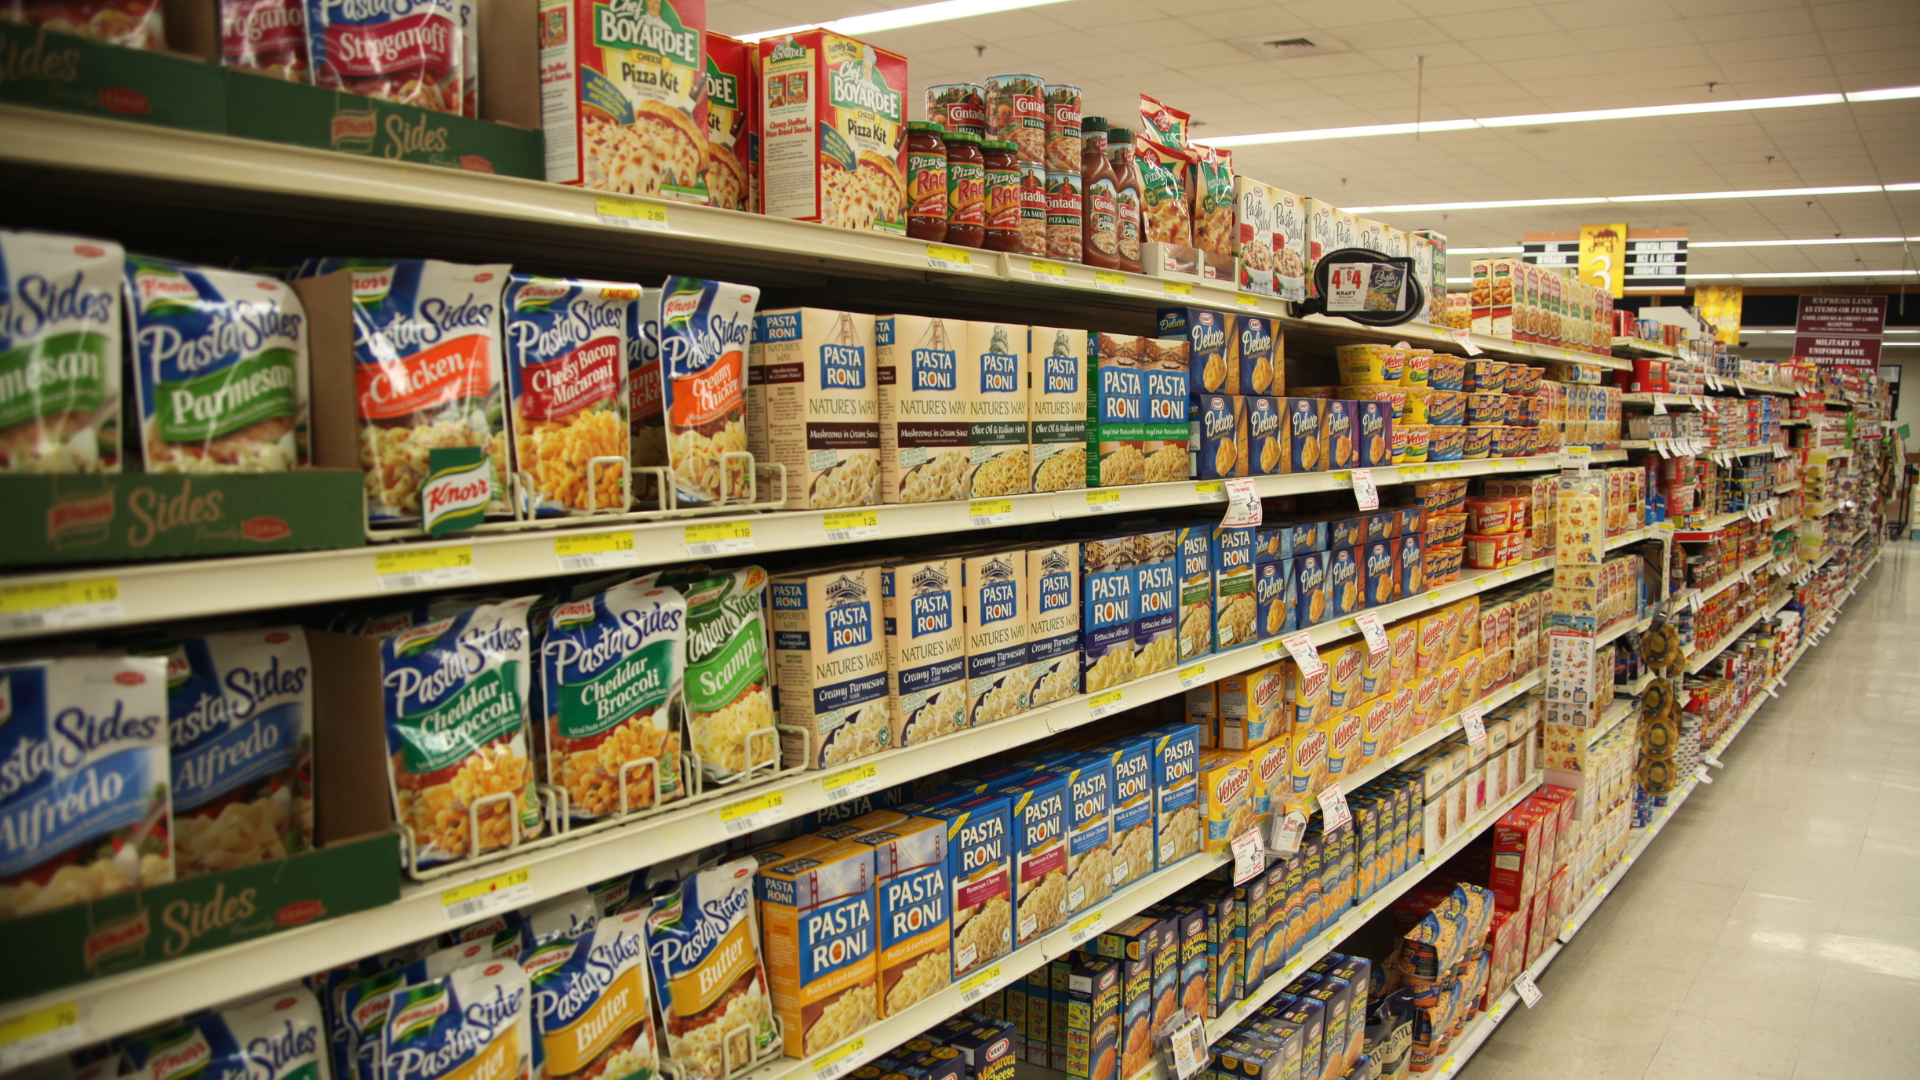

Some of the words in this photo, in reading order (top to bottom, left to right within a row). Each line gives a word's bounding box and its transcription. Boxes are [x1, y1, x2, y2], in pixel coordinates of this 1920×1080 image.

[340, 22, 447, 62] Stroganoff
[601, 9, 695, 63] BOYARDEE
[637, 51, 663, 65] CHEESE
[771, 47, 804, 62] BOYARDEE
[828, 44, 845, 54] Family
[847, 43, 857, 53] Size
[621, 61, 657, 86] Pizza
[660, 67, 679, 94] Kit
[840, 61, 861, 80] Chef
[834, 75, 898, 118] BOYARDEE
[770, 121, 786, 130] Cheesy
[787, 117, 807, 126] Stuffed
[857, 111, 875, 121] CHEESE
[766, 130, 777, 138] Pizza
[848, 118, 871, 138] Pizza
[873, 124, 887, 144] Kit
[910, 157, 934, 171] Pizza
[647, 210, 665, 222] 2.89
[1244, 192, 1264, 220] Pasta
[1048, 216, 1065, 224] PIZZA
[1332, 270, 1341, 289] 4
[1347, 270, 1362, 289] $4
[1374, 279, 1397, 288] Salad
[1591, 254, 1612, 292] 3
[518, 285, 566, 304] Knorr
[608, 288, 634, 299] NEW!
[420, 293, 493, 345] Sides
[664, 298, 698, 319] Knorr
[507, 315, 574, 370] Pasta
[571, 300, 623, 342] Sides
[662, 335, 712, 382] Pasta
[709, 312, 749, 357] Sides
[1192, 320, 1225, 351] Deluxe
[139, 324, 242, 387] Pasta
[825, 347, 861, 368] PASTA
[1804, 357, 1833, 365] RIORITY
[1809, 347, 1842, 355] UNIFORM
[369, 351, 466, 404] Chicken
[531, 359, 579, 398] Cheesy
[577, 342, 618, 371] Bacon
[692, 362, 732, 401] Creamy
[827, 368, 860, 387] RONI
[170, 364, 293, 425] Parmesan
[552, 361, 614, 408] Macaroni
[1104, 371, 1141, 395] PASTA
[701, 379, 740, 412] Chicken
[809, 398, 856, 416] NATURE'S
[859, 399, 877, 416] WAY
[1107, 399, 1139, 418] RONI
[810, 429, 842, 440] Mushrooms
[843, 429, 849, 438] in
[849, 429, 864, 440] Cream
[865, 430, 878, 439] Sauce
[972, 425, 983, 436] Olive
[983, 426, 992, 435] Oil
[999, 425, 1014, 434] Italian
[1015, 425, 1026, 434] Herb
[1205, 409, 1234, 438] Deluxe
[1362, 412, 1383, 438] Deluxe
[424, 477, 490, 514] Knorr
[128, 479, 224, 547] Sides
[1000, 504, 1011, 513] 1.25
[734, 527, 750, 539] 1.19
[863, 517, 877, 526] 1.25
[615, 541, 633, 551] 1.19
[1222, 530, 1250, 549] PASTA
[454, 554, 470, 566] .79
[1223, 550, 1249, 567] RONI
[1092, 576, 1130, 600] PASTA
[1257, 576, 1284, 600] Deluxe
[557, 603, 594, 623] Knorr
[830, 609, 868, 629] PASTA
[1094, 600, 1128, 625] RONI
[545, 628, 625, 684] Pasta
[621, 602, 682, 661] Sides
[833, 629, 867, 647] RONI
[1115, 627, 1129, 638] Alfredo
[700, 635, 758, 697] Scampi
[816, 656, 863, 679] NATURE'S
[865, 651, 884, 670] WAY
[1335, 652, 1362, 683] Velveeta
[225, 656, 307, 720] Sides
[582, 655, 648, 705] Cheddar
[820, 685, 847, 702] Creamy
[850, 676, 885, 696] Parmesano
[1254, 675, 1281, 706] Velveeta
[596, 668, 660, 722] Broccoli
[54, 700, 161, 768] Sides
[174, 722, 279, 792] Alfredo
[1164, 740, 1194, 763] PASTA
[1297, 731, 1327, 766] Velveeta
[862, 767, 875, 778] 1.25
[1165, 760, 1193, 782] RONI
[1218, 769, 1249, 802] Velveeta
[0, 771, 123, 852] Alfredo
[767, 796, 782, 808] 1.19
[961, 816, 1004, 849] PASTA
[963, 842, 1002, 872] RONI
[507, 871, 528, 885] 1.19
[967, 880, 987, 895] Parmesan
[986, 875, 1001, 888] Cheese
[162, 883, 256, 956] Sides
[808, 899, 870, 945] PASTA
[813, 931, 869, 973] RONI
[1181, 932, 1207, 952] Macaroni
[1187, 942, 1207, 958] Cheese
[698, 937, 745, 996] Butter
[533, 970, 599, 1037] Pasta
[588, 932, 641, 985] Sides
[807, 980, 827, 996] Butter
[834, 972, 850, 986] Herb
[575, 986, 630, 1054] Butter
[991, 1043, 1005, 1057] KRAFT
